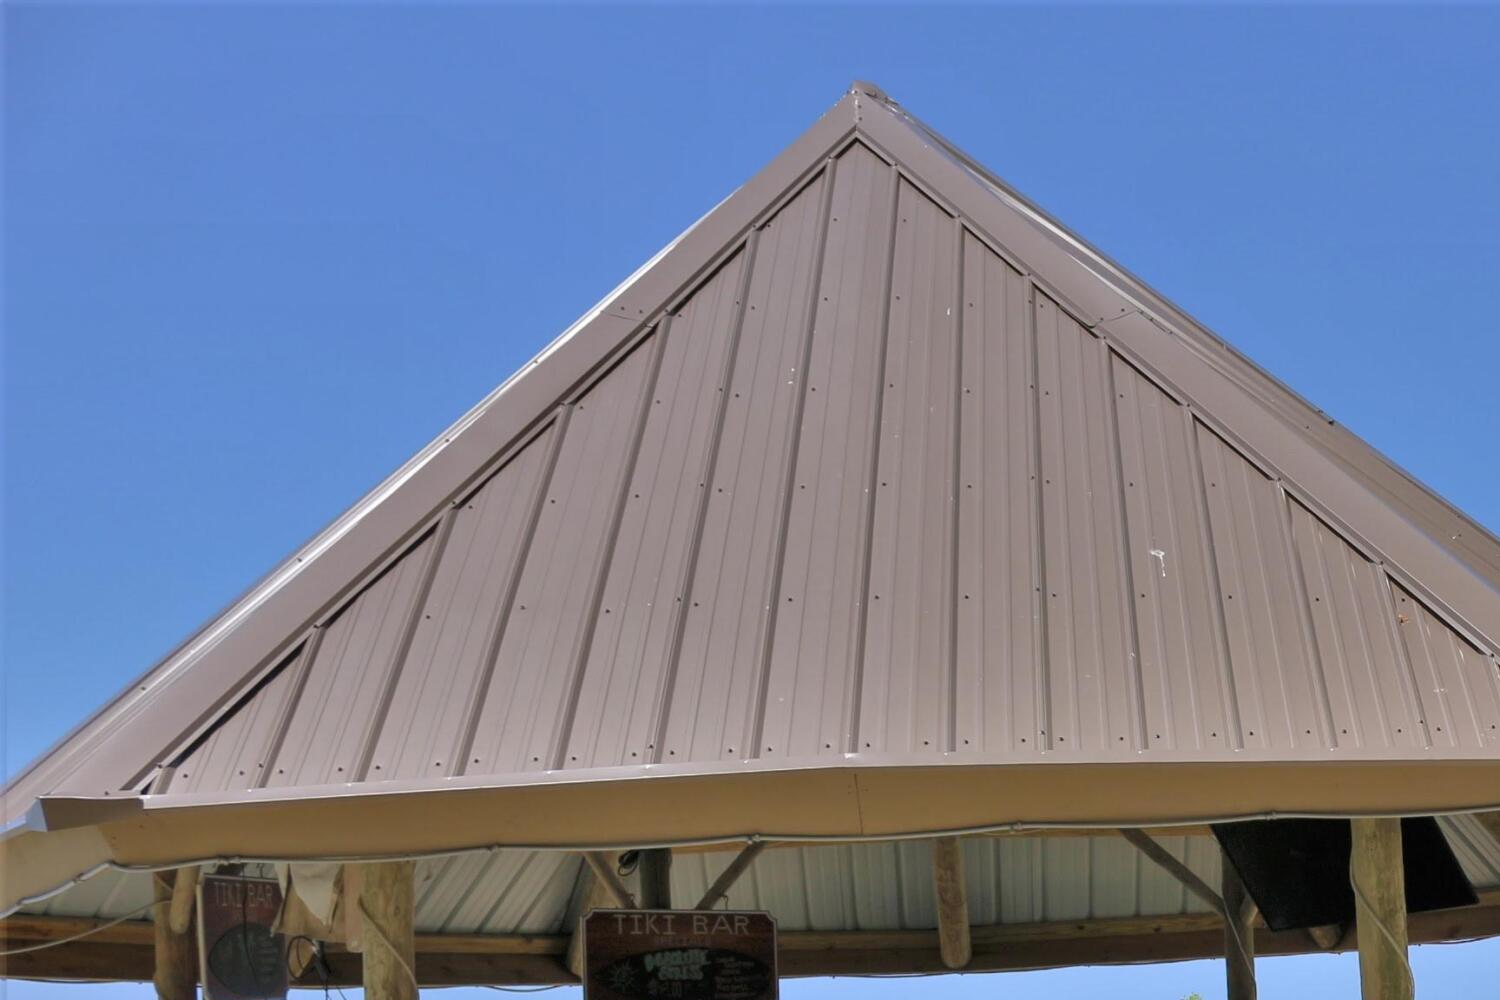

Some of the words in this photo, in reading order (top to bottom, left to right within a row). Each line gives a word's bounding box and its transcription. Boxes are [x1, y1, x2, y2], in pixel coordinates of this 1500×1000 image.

[247, 883, 273, 908] BAR
[613, 914, 676, 935] TIKI
[692, 914, 750, 935] BAR
